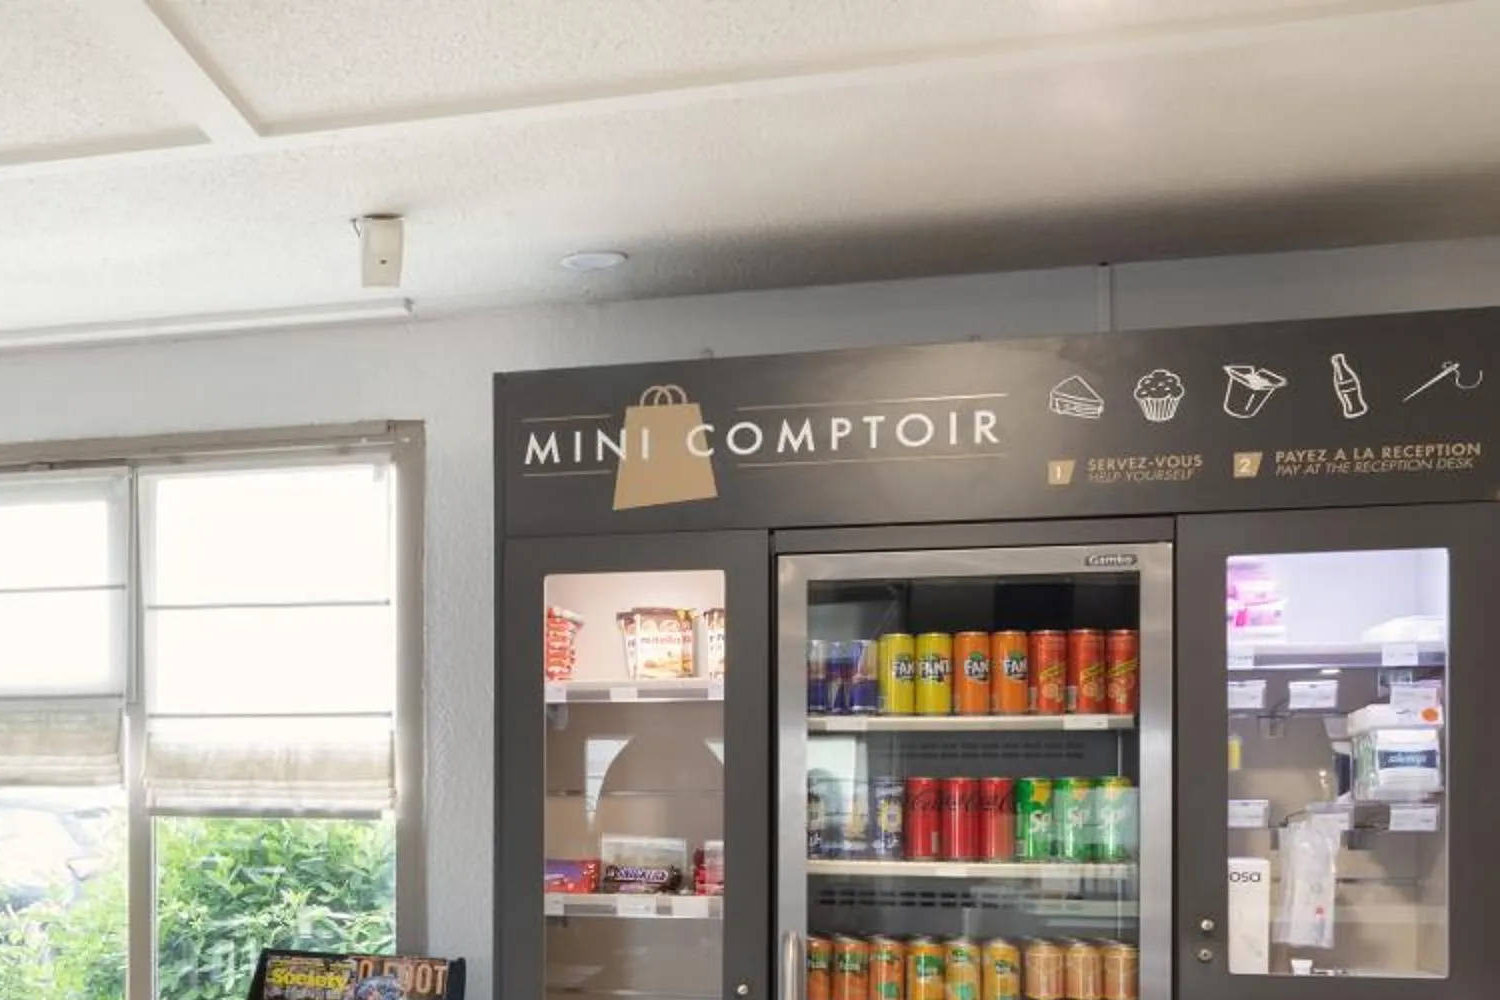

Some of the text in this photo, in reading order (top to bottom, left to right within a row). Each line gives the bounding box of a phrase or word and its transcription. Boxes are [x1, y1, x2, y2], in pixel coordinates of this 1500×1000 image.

[524, 410, 1000, 465] MINI COMPTOIR
[1275, 442, 1481, 463] PAYEZ A LA RECEPTION
[1087, 454, 1204, 472] SERVEZ-VOUS
[1239, 458, 1251, 474] 2
[1276, 457, 1474, 477] PAY AT THE RECEPTION DESK
[1126, 469, 1193, 482] YOURSELF
